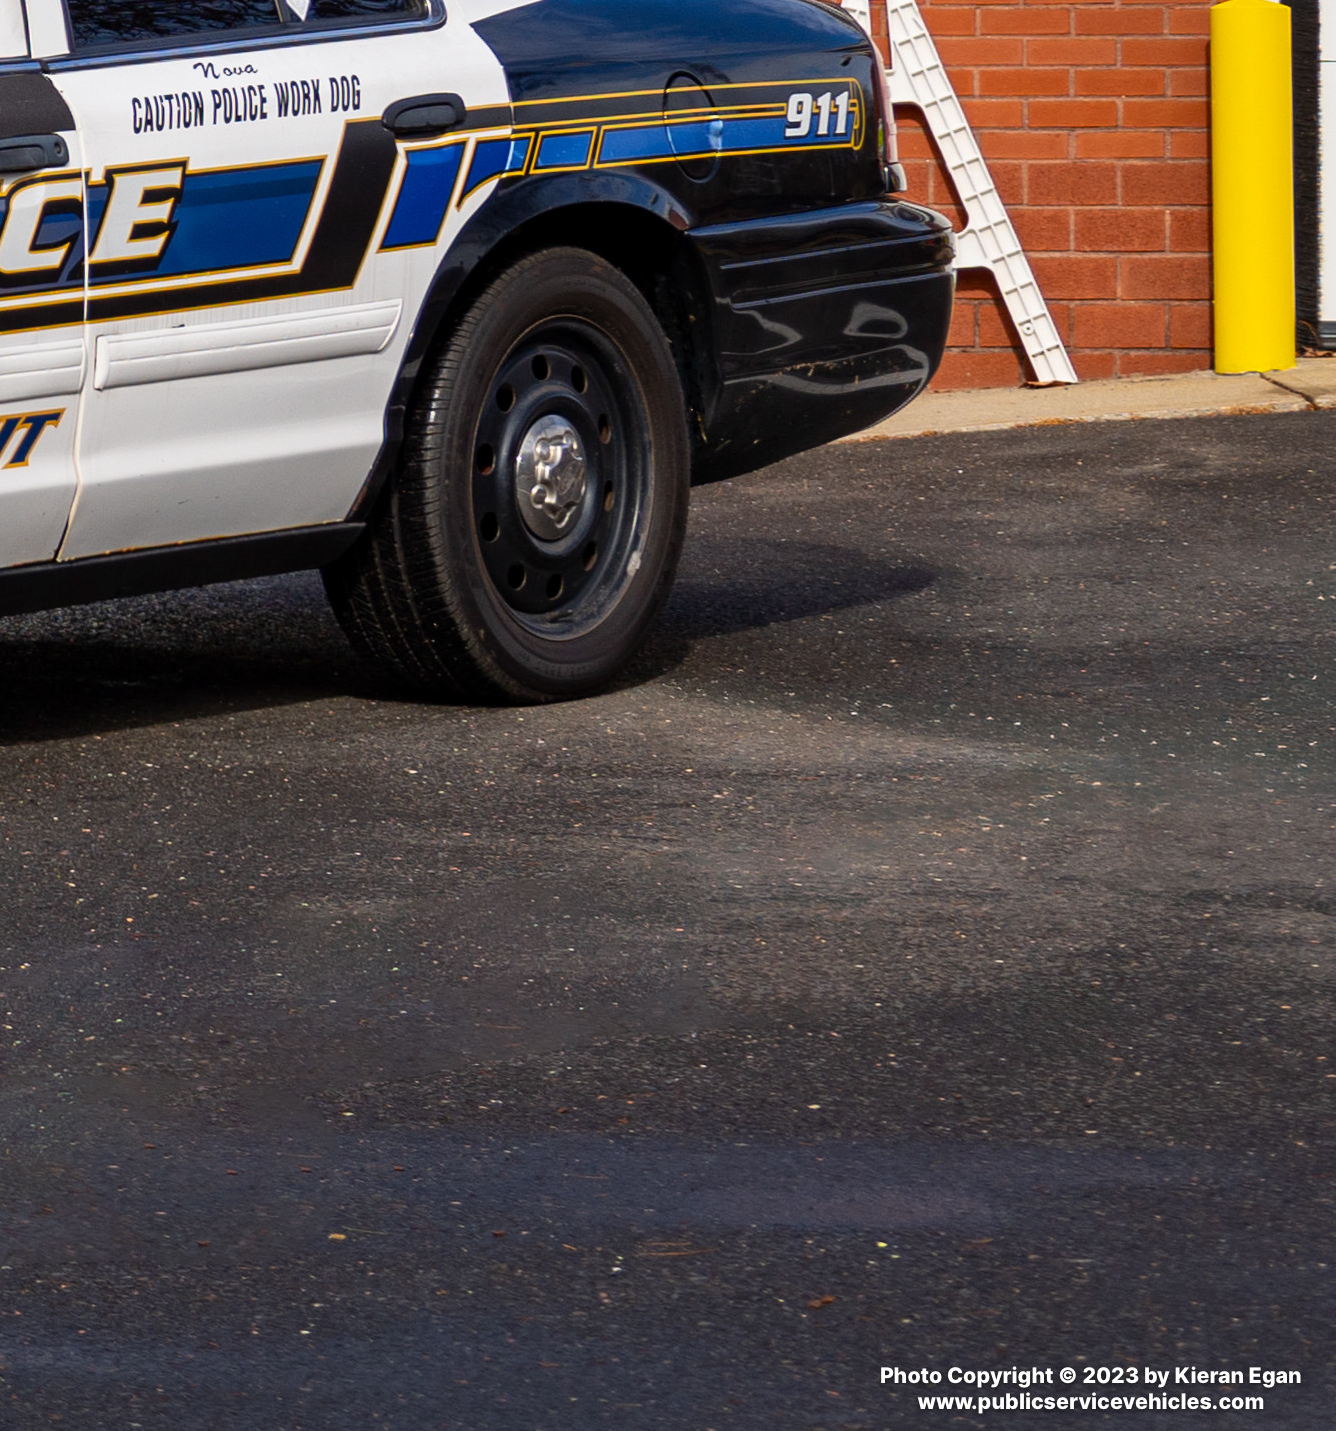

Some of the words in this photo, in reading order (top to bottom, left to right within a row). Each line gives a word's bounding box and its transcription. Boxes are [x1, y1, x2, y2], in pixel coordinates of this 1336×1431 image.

[193, 62, 259, 79] Nova
[131, 90, 204, 134] CAUTION
[211, 83, 268, 125] POLICE
[273, 78, 322, 118] WORK
[329, 74, 361, 113] DOG
[784, 91, 849, 138] 911
